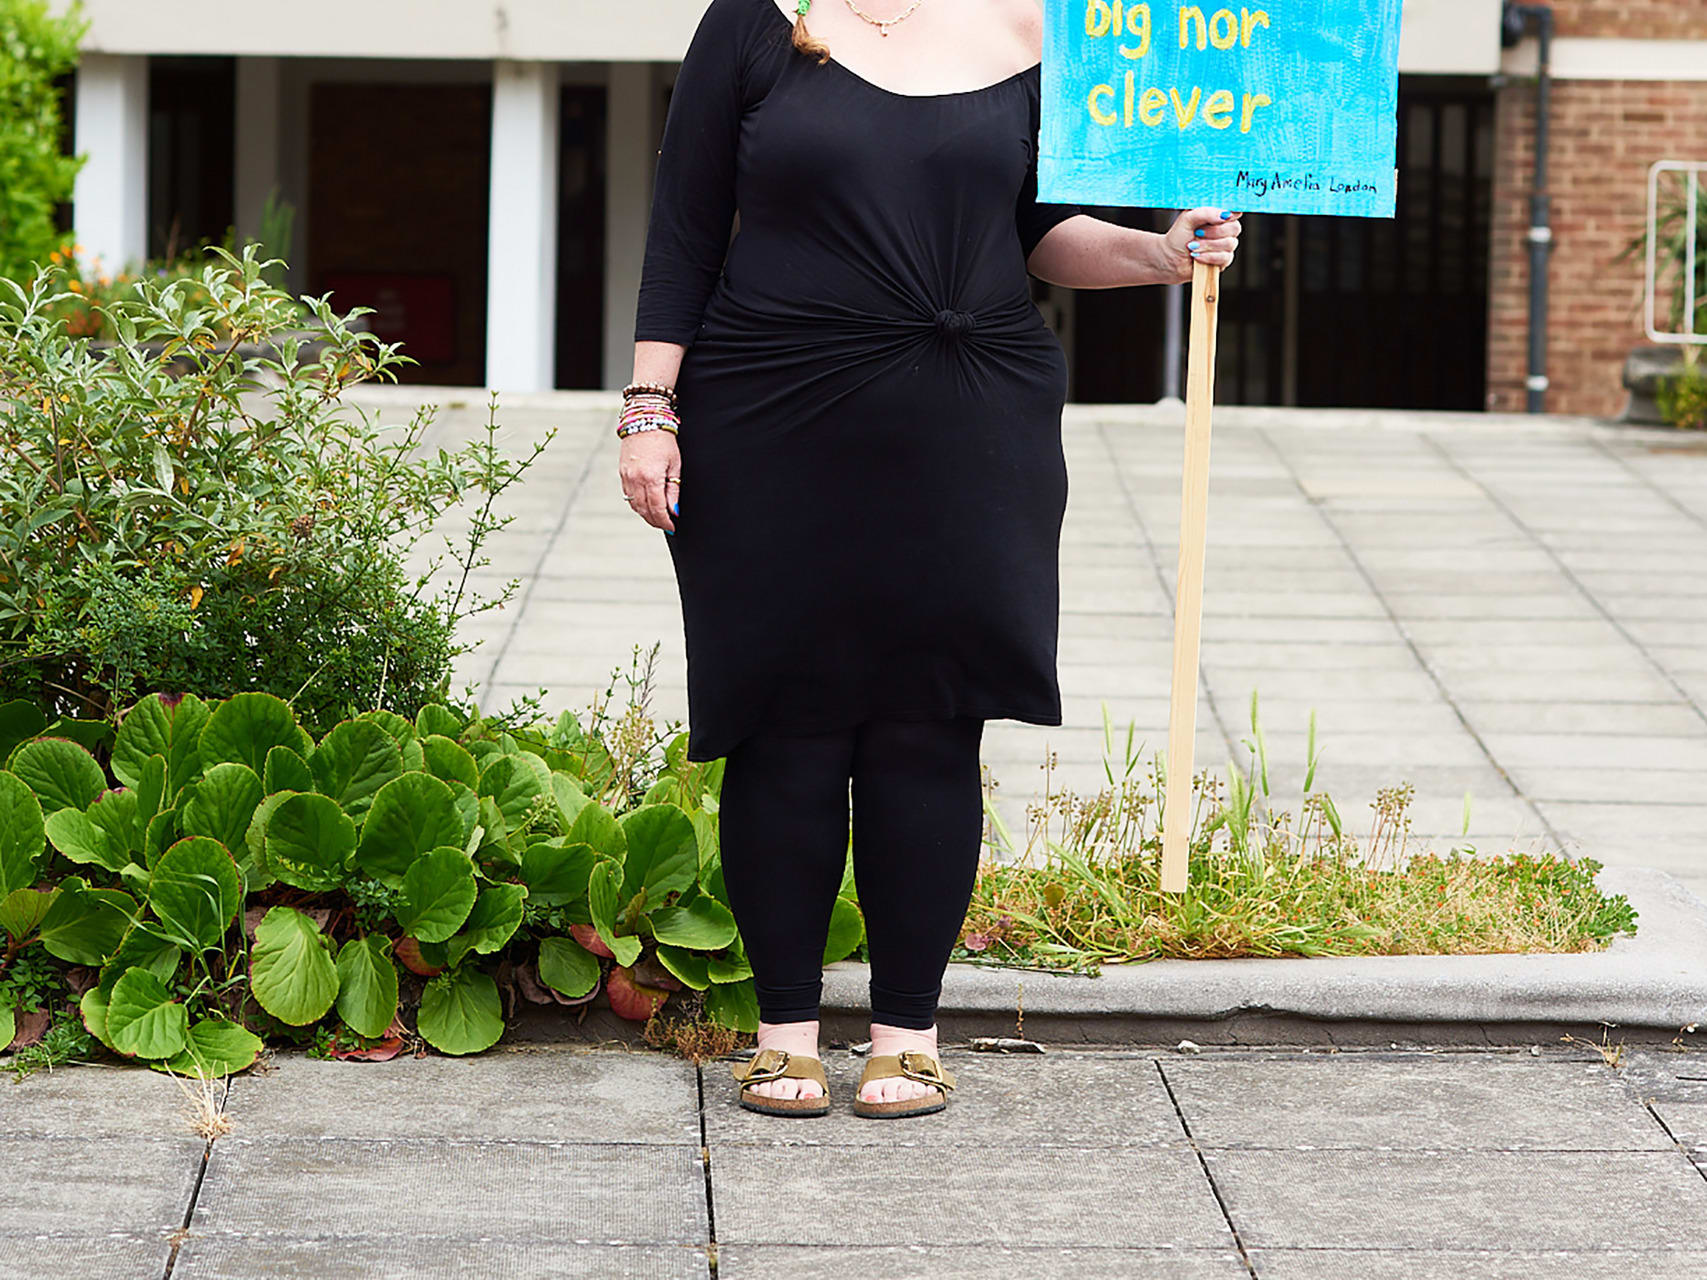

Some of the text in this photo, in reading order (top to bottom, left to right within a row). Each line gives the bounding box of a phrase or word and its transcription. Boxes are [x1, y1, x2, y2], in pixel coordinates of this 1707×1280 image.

[1179, 5, 1271, 51] nor
[1087, 70, 1273, 134] clever
[1235, 169, 1268, 198] Mary
[1329, 175, 1378, 195] London
